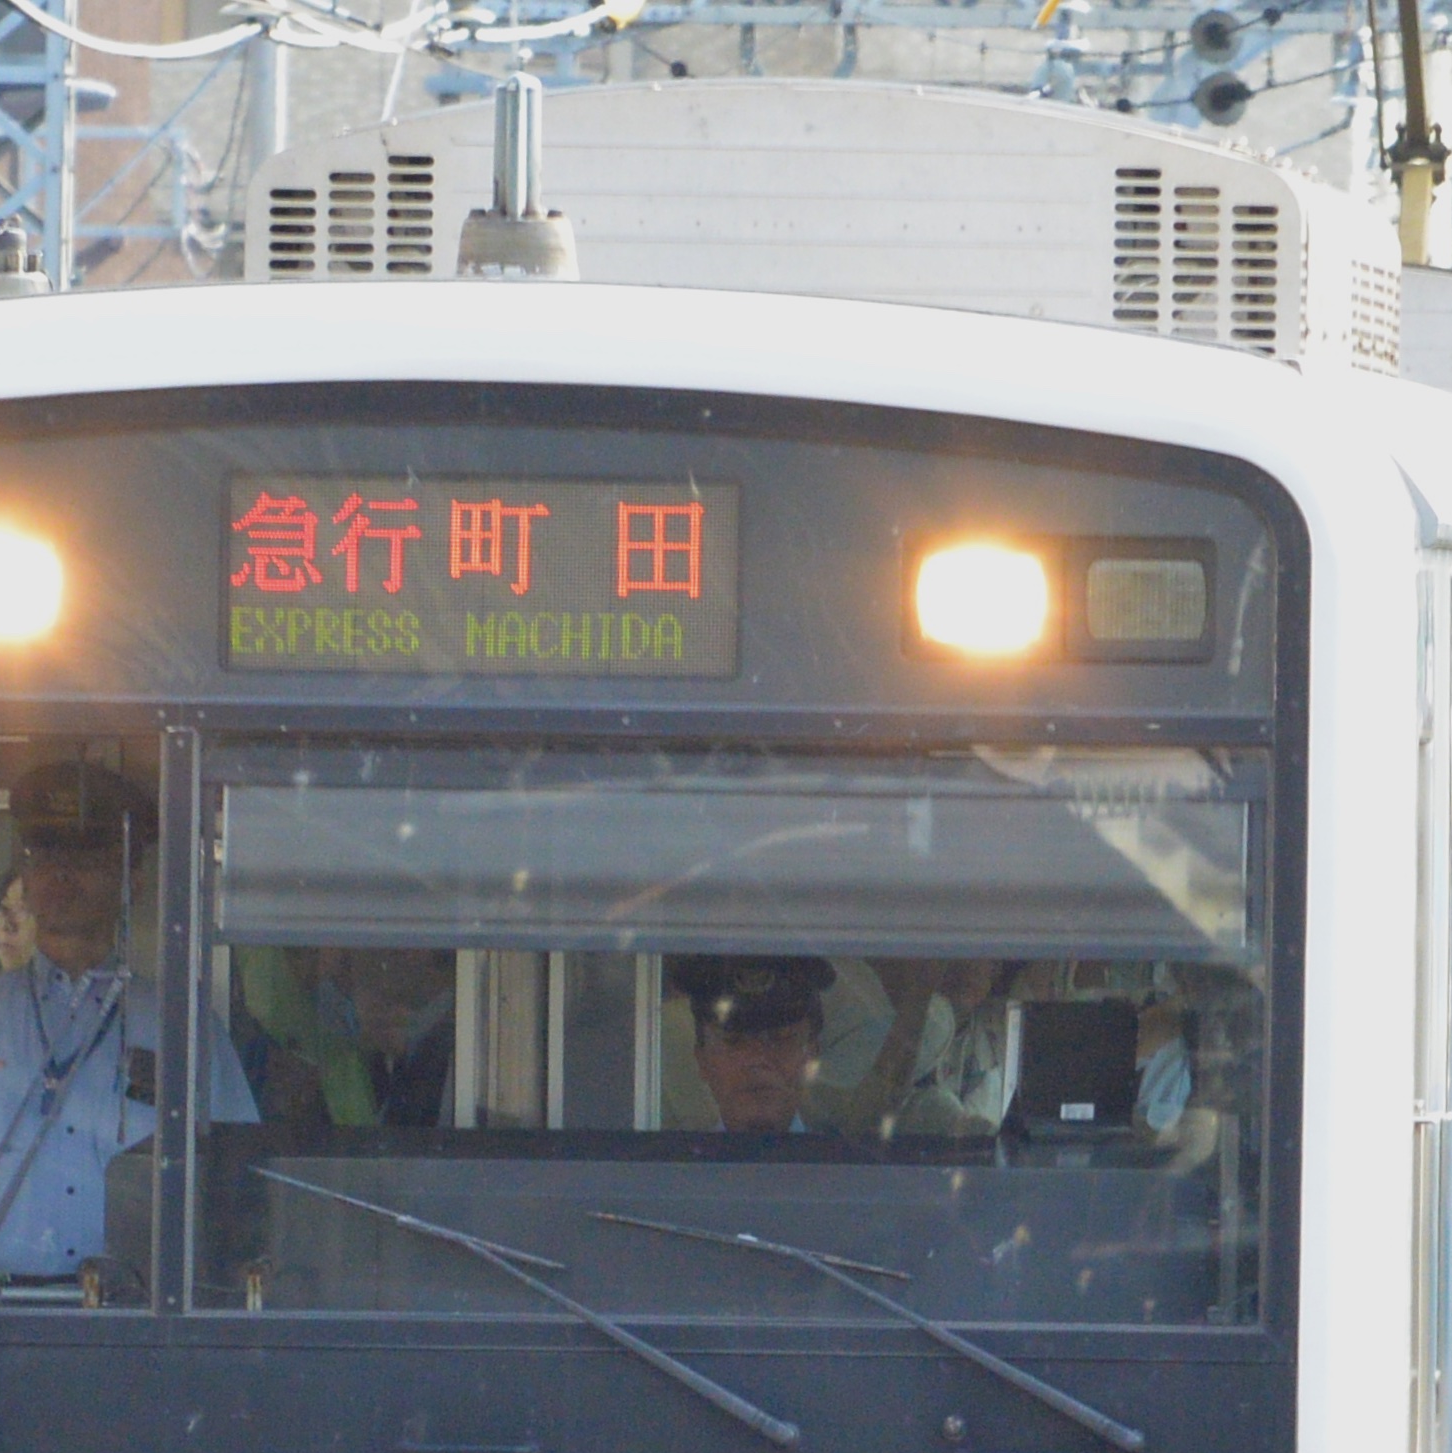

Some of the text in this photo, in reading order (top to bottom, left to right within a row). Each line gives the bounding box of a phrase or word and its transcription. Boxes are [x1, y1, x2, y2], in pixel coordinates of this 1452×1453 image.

[231, 491, 420, 593] 急行
[230, 606, 684, 659] EXPRESS MACHIDA
